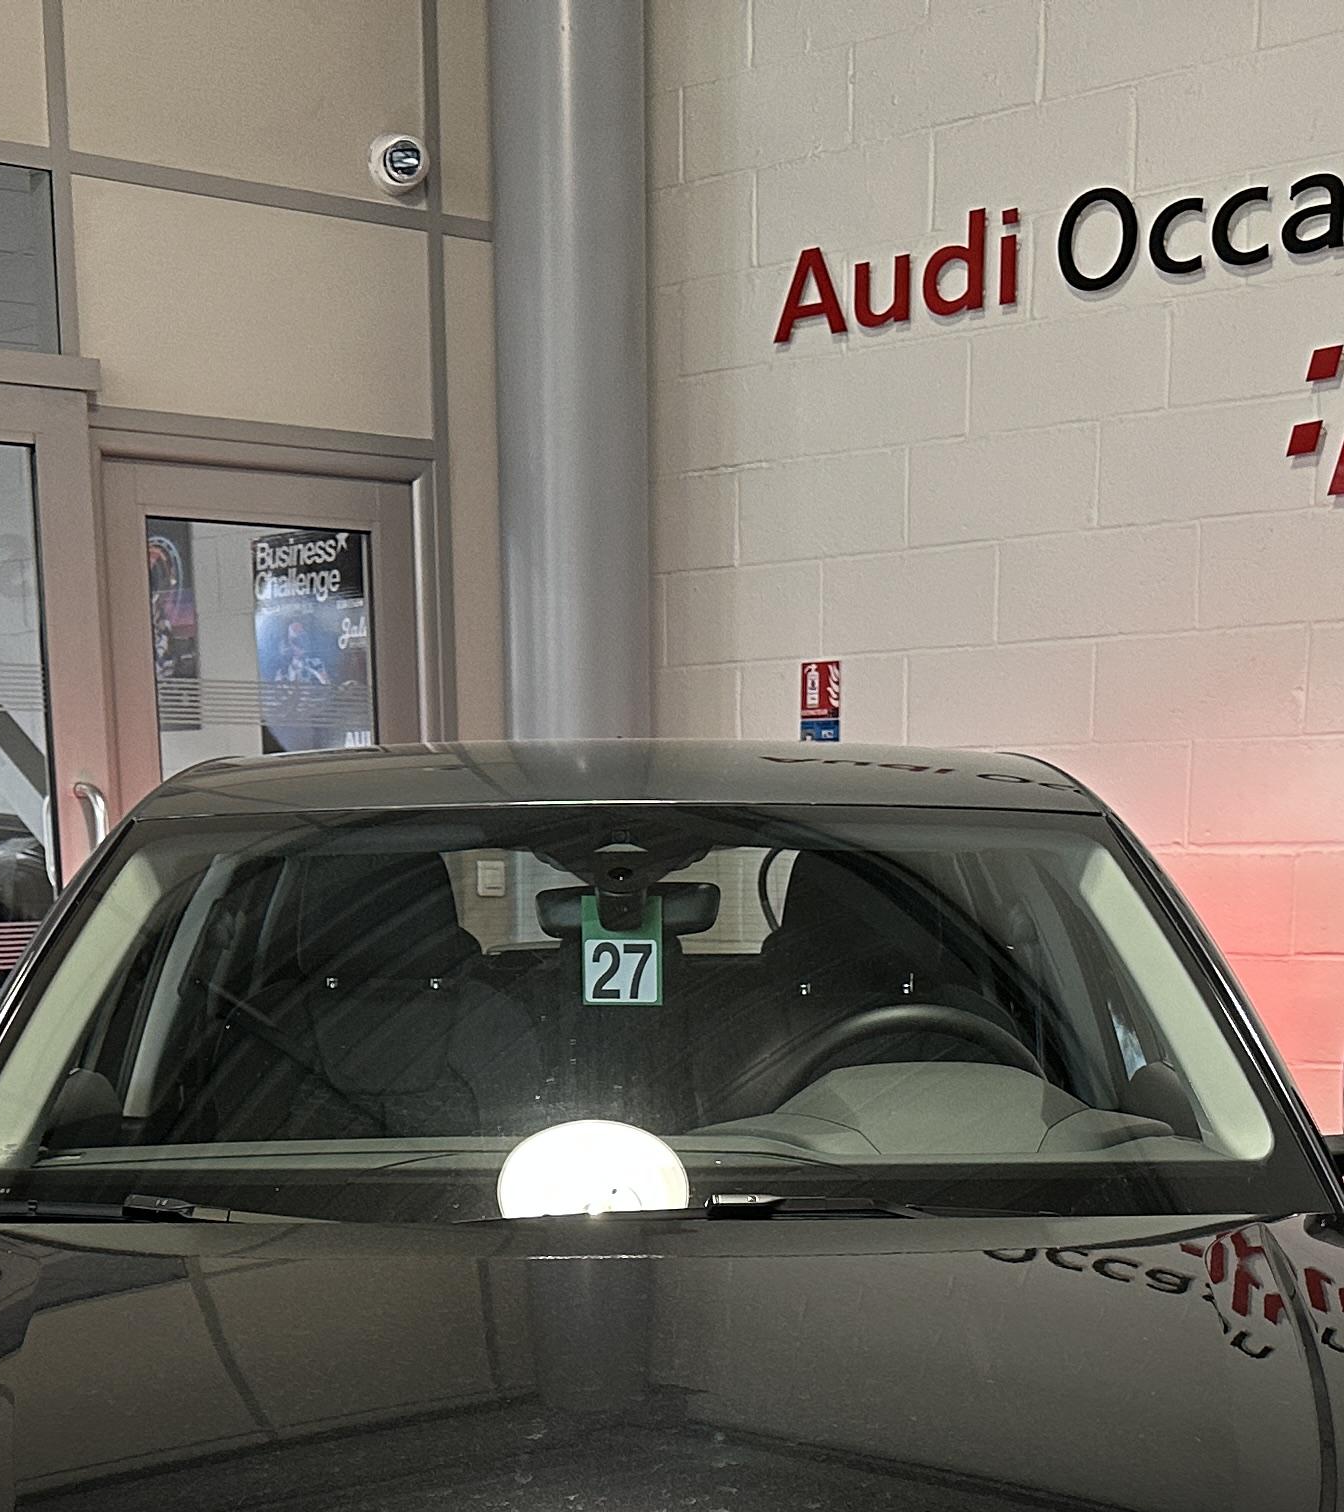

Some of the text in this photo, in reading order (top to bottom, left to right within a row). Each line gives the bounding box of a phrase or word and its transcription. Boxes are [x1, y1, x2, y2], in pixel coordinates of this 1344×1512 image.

[774, 208, 1019, 344] Audi
[257, 538, 336, 570] Business
[255, 568, 341, 602] Challenge
[592, 941, 652, 999] 27
